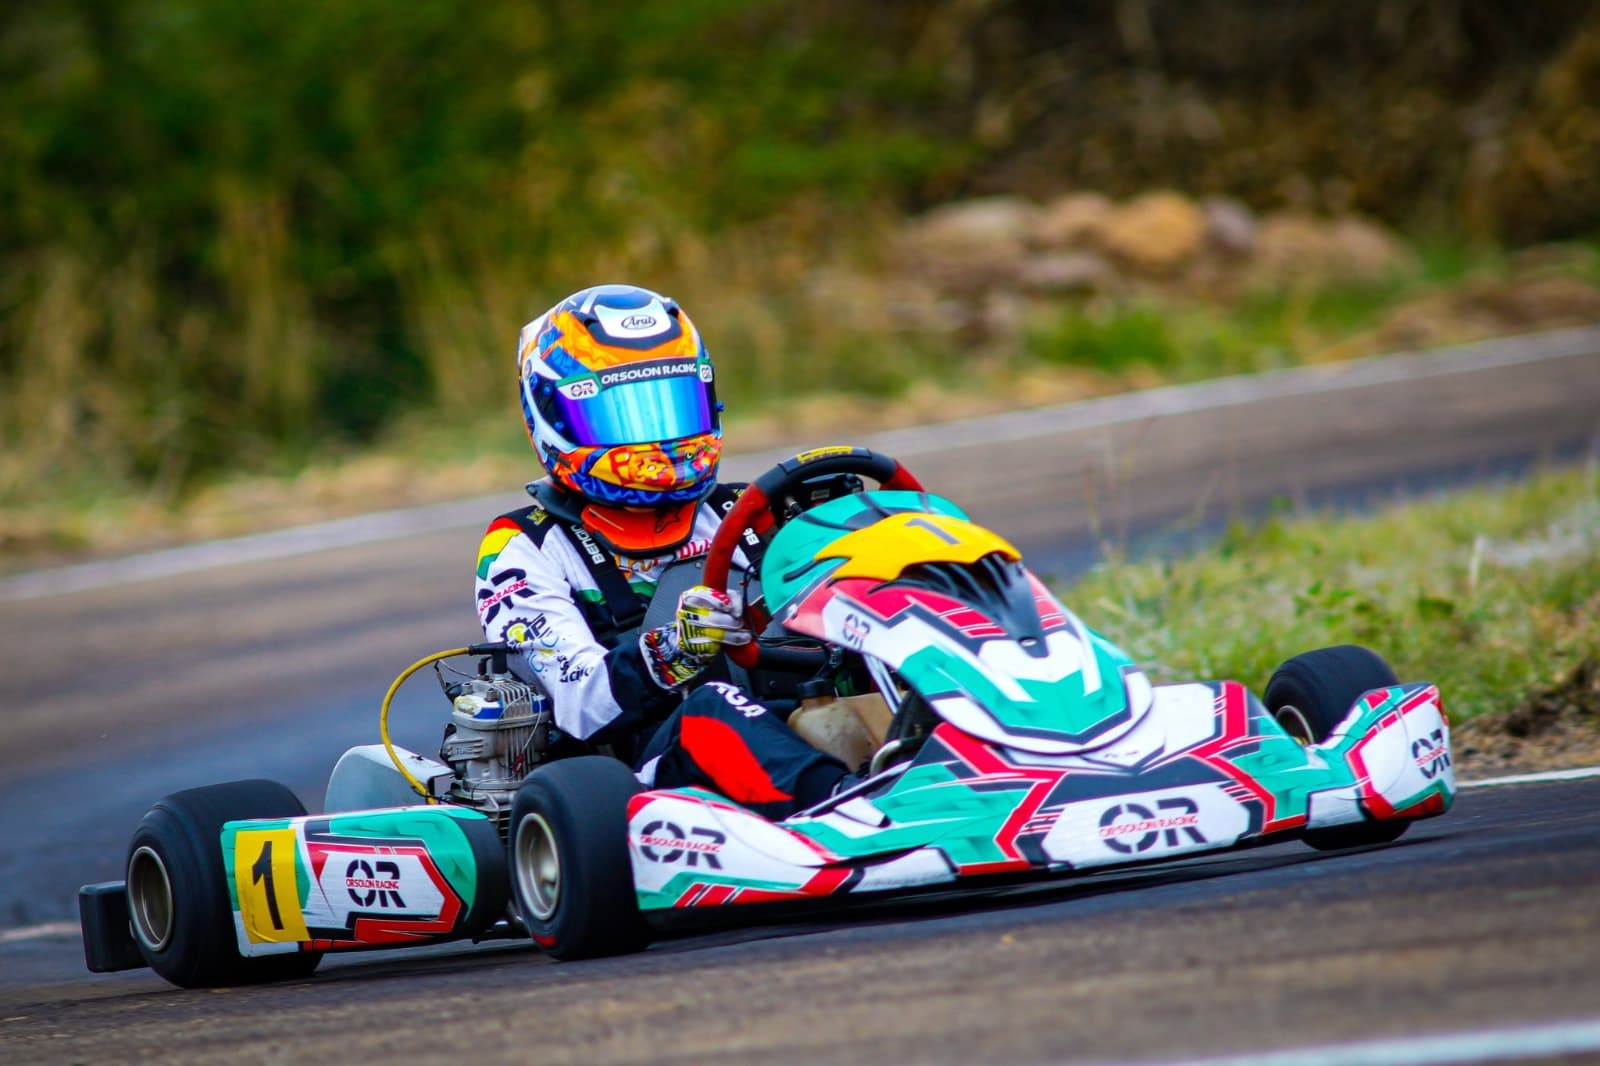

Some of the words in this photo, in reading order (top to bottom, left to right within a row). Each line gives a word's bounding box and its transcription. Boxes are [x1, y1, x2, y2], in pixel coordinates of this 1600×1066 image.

[600, 366, 660, 385] ORSOLON
[662, 362, 697, 375] RACING
[904, 517, 961, 545] 1
[640, 819, 727, 870] OR
[1098, 796, 1209, 855] OR
[251, 840, 285, 931] 1
[345, 859, 408, 909] OR
